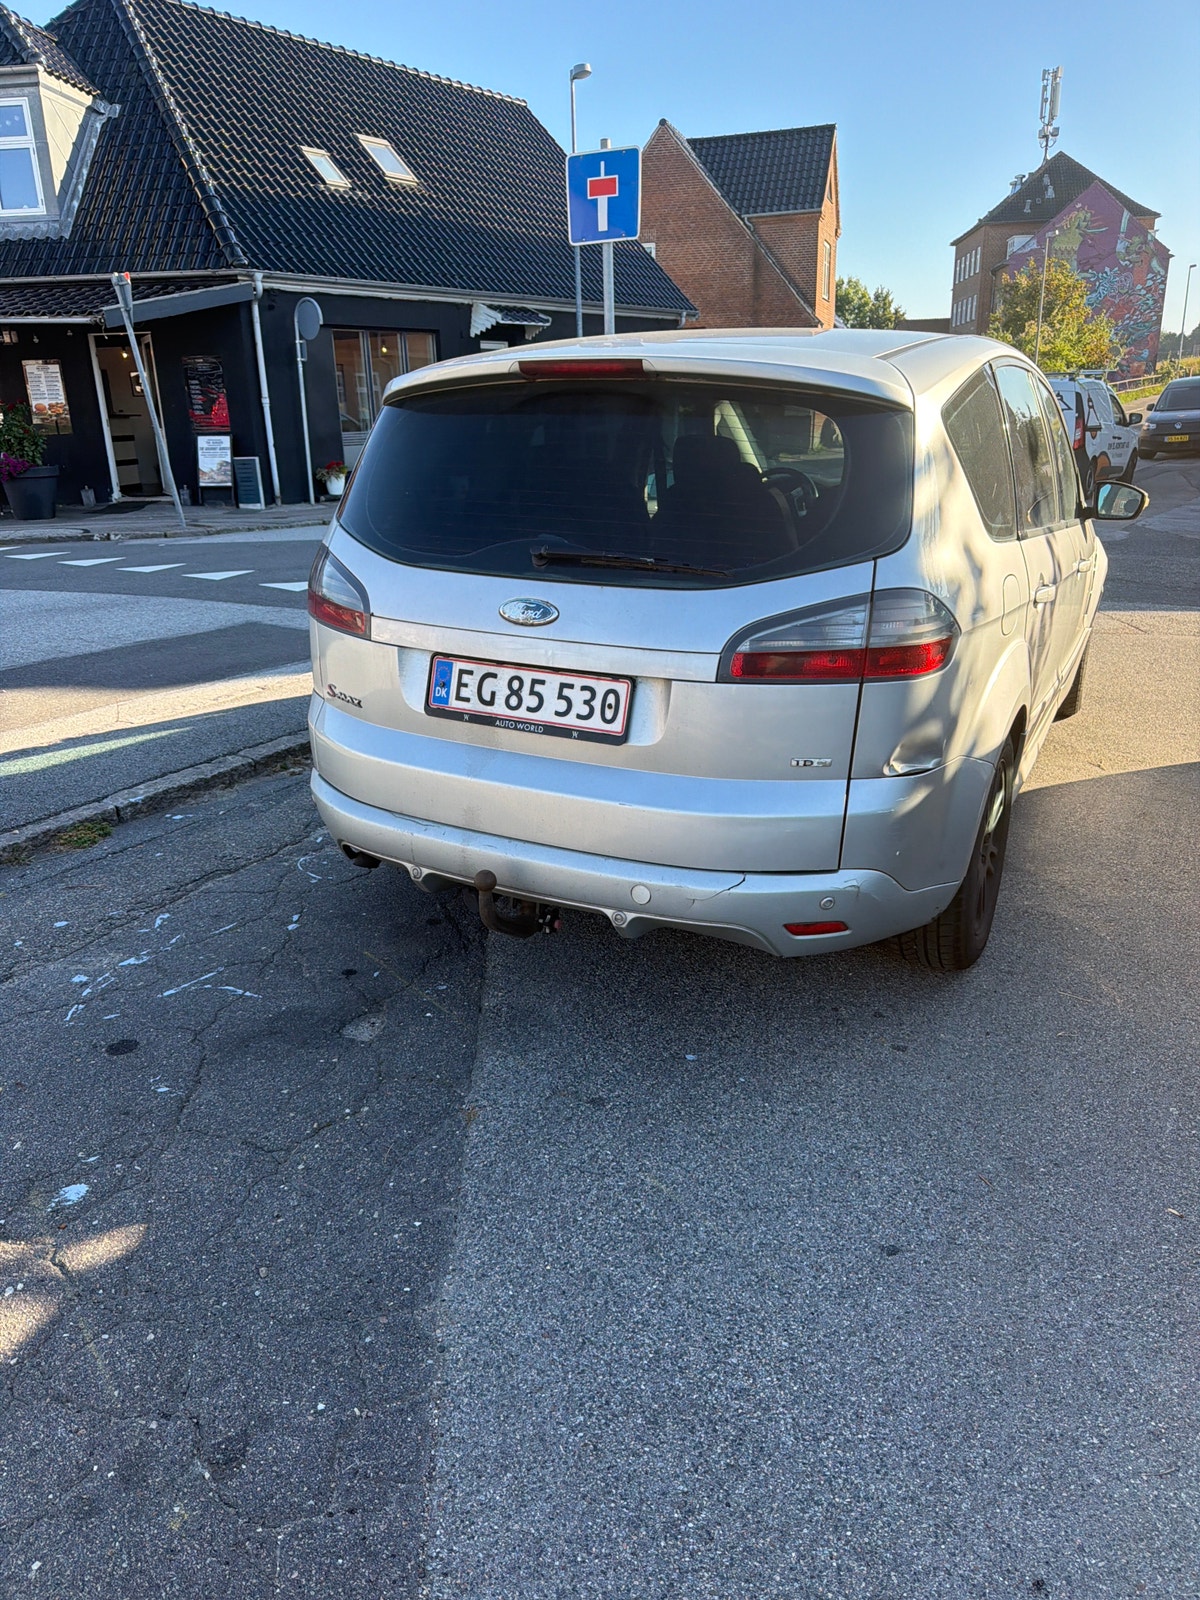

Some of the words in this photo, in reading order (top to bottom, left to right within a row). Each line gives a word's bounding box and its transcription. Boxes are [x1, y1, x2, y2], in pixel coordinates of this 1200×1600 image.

[508, 602, 544, 619] Ford
[435, 687, 448, 699] DK
[454, 668, 498, 707] EG
[504, 675, 546, 713] 85
[554, 682, 621, 725] 530
[495, 719, 515, 729] AUTO
[516, 721, 544, 733] WORLD
